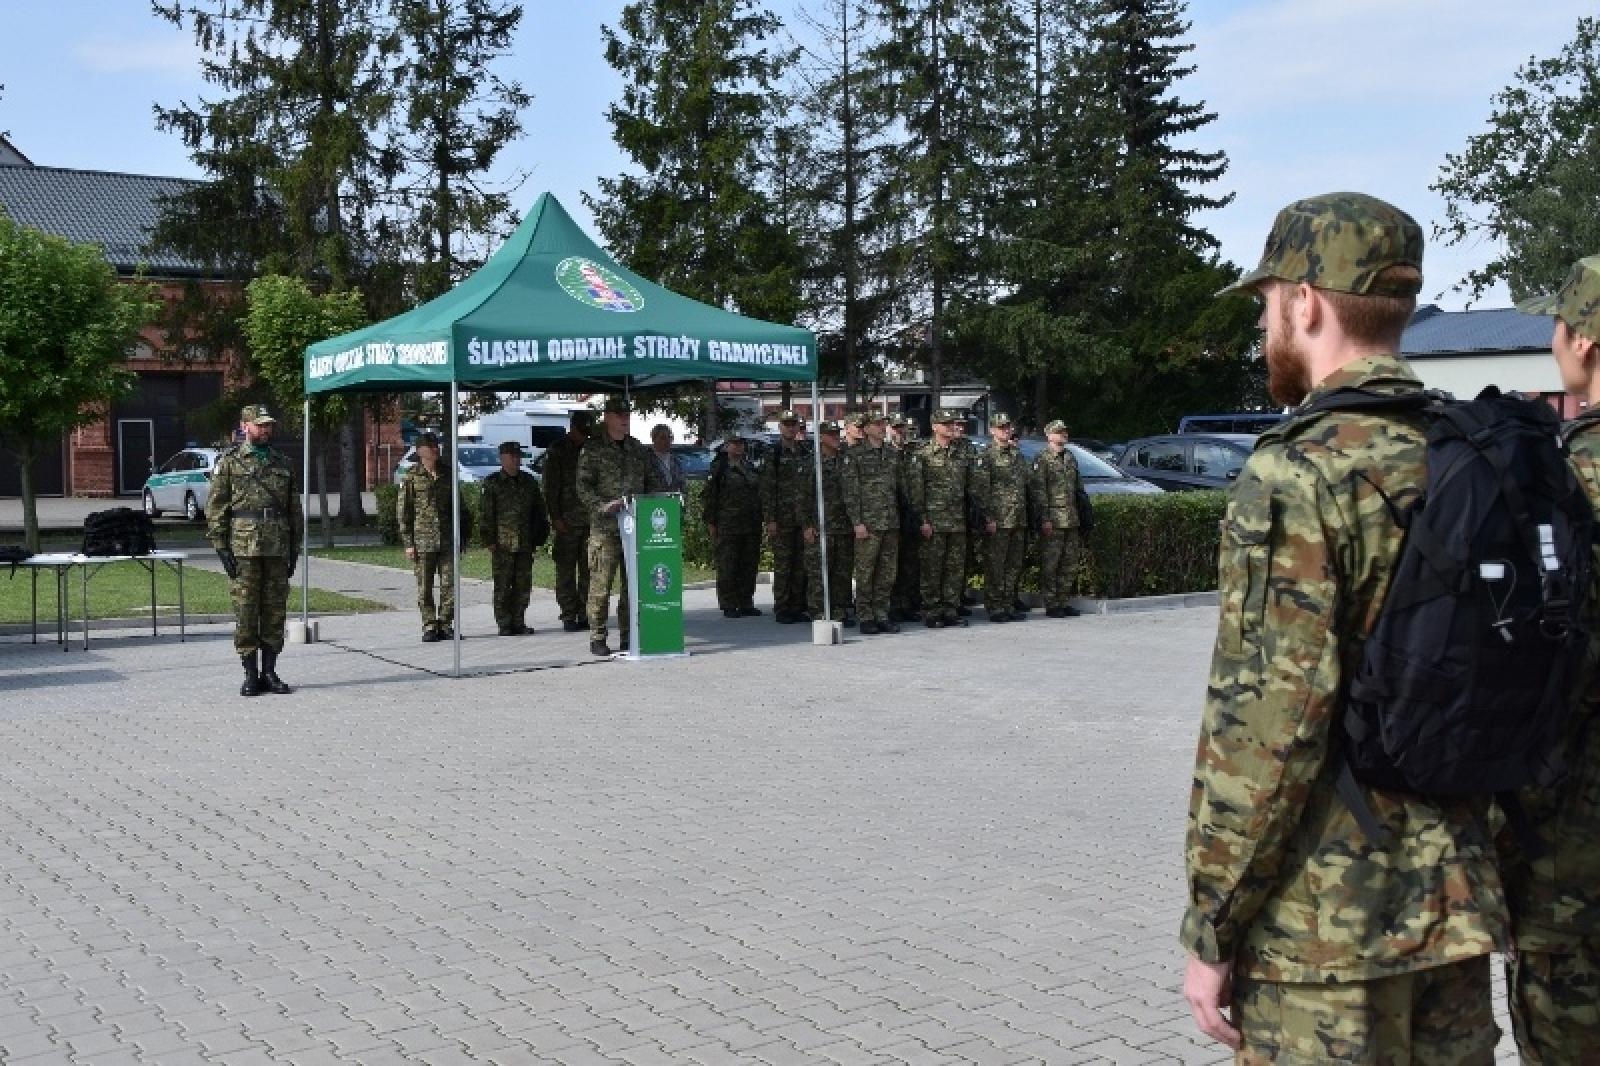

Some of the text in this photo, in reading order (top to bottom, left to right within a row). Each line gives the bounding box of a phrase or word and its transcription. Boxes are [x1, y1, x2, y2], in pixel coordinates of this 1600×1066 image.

[467, 335, 539, 367] ŚLĄSKI
[548, 335, 627, 361] ODDZIAŁ
[633, 333, 701, 360] STRAŻY
[708, 338, 808, 365] GRANICZNEJ
